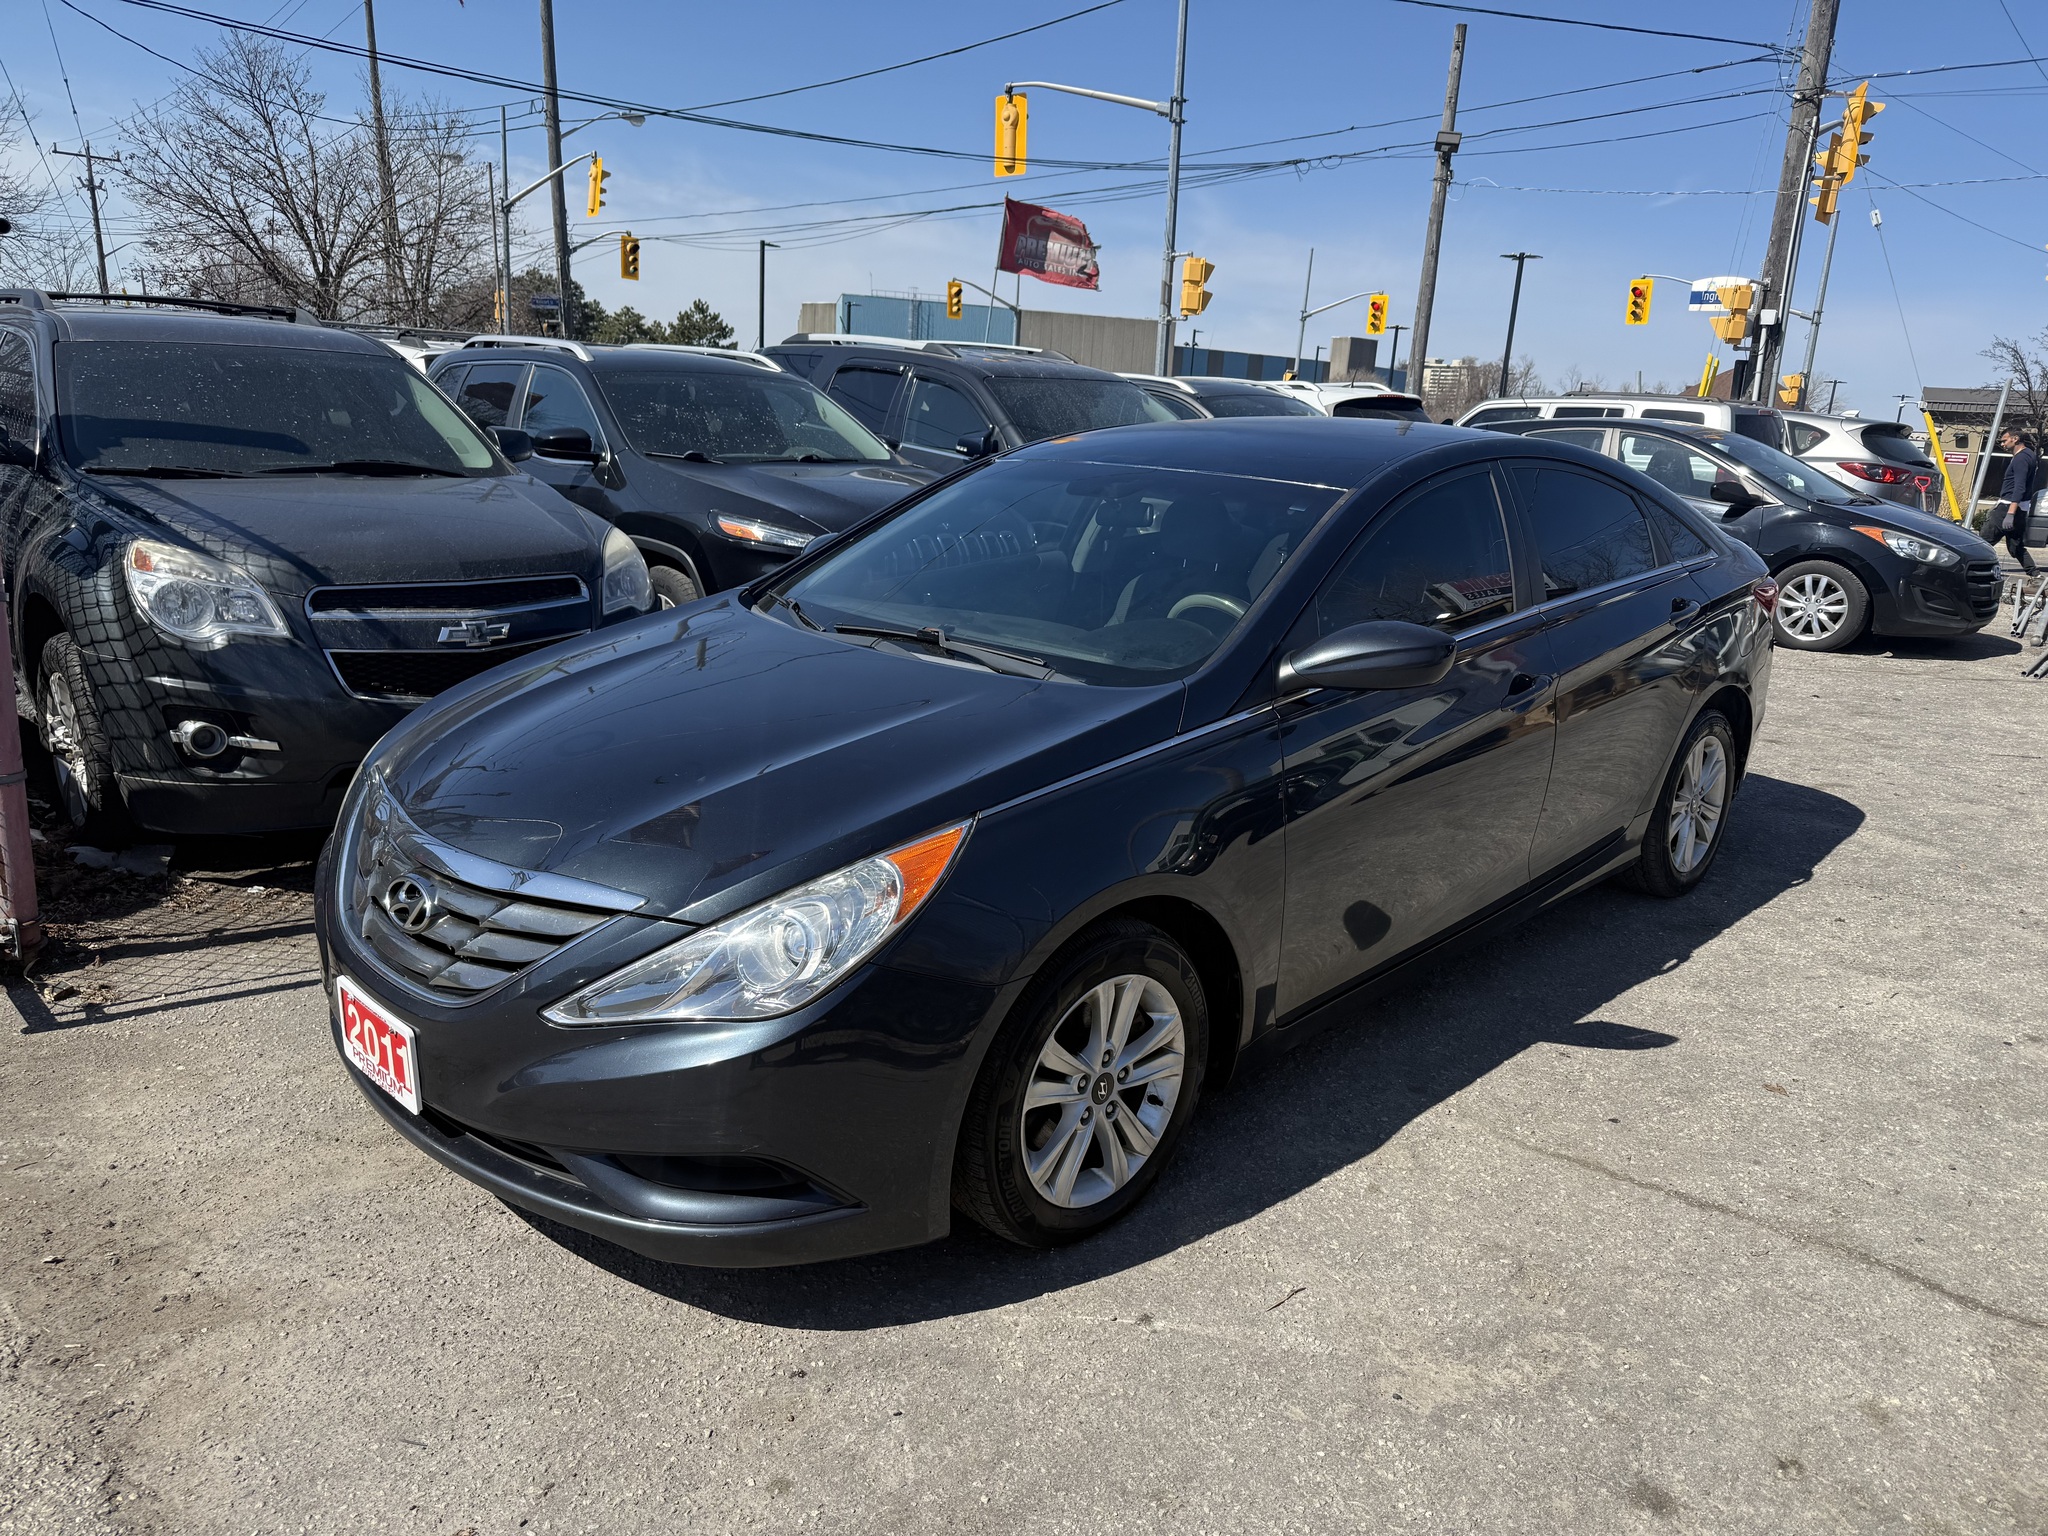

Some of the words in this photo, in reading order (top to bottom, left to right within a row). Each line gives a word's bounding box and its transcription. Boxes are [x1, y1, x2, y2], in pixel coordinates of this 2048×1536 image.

[1015, 235, 1096, 270] PREMIUM
[1018, 258, 1040, 269] AUTO
[1044, 263, 1066, 275] SALES
[347, 1003, 411, 1090] 2011
[353, 1046, 404, 1097] PREMIUM
[998, 1115, 1032, 1223] BRIDGESTONE
